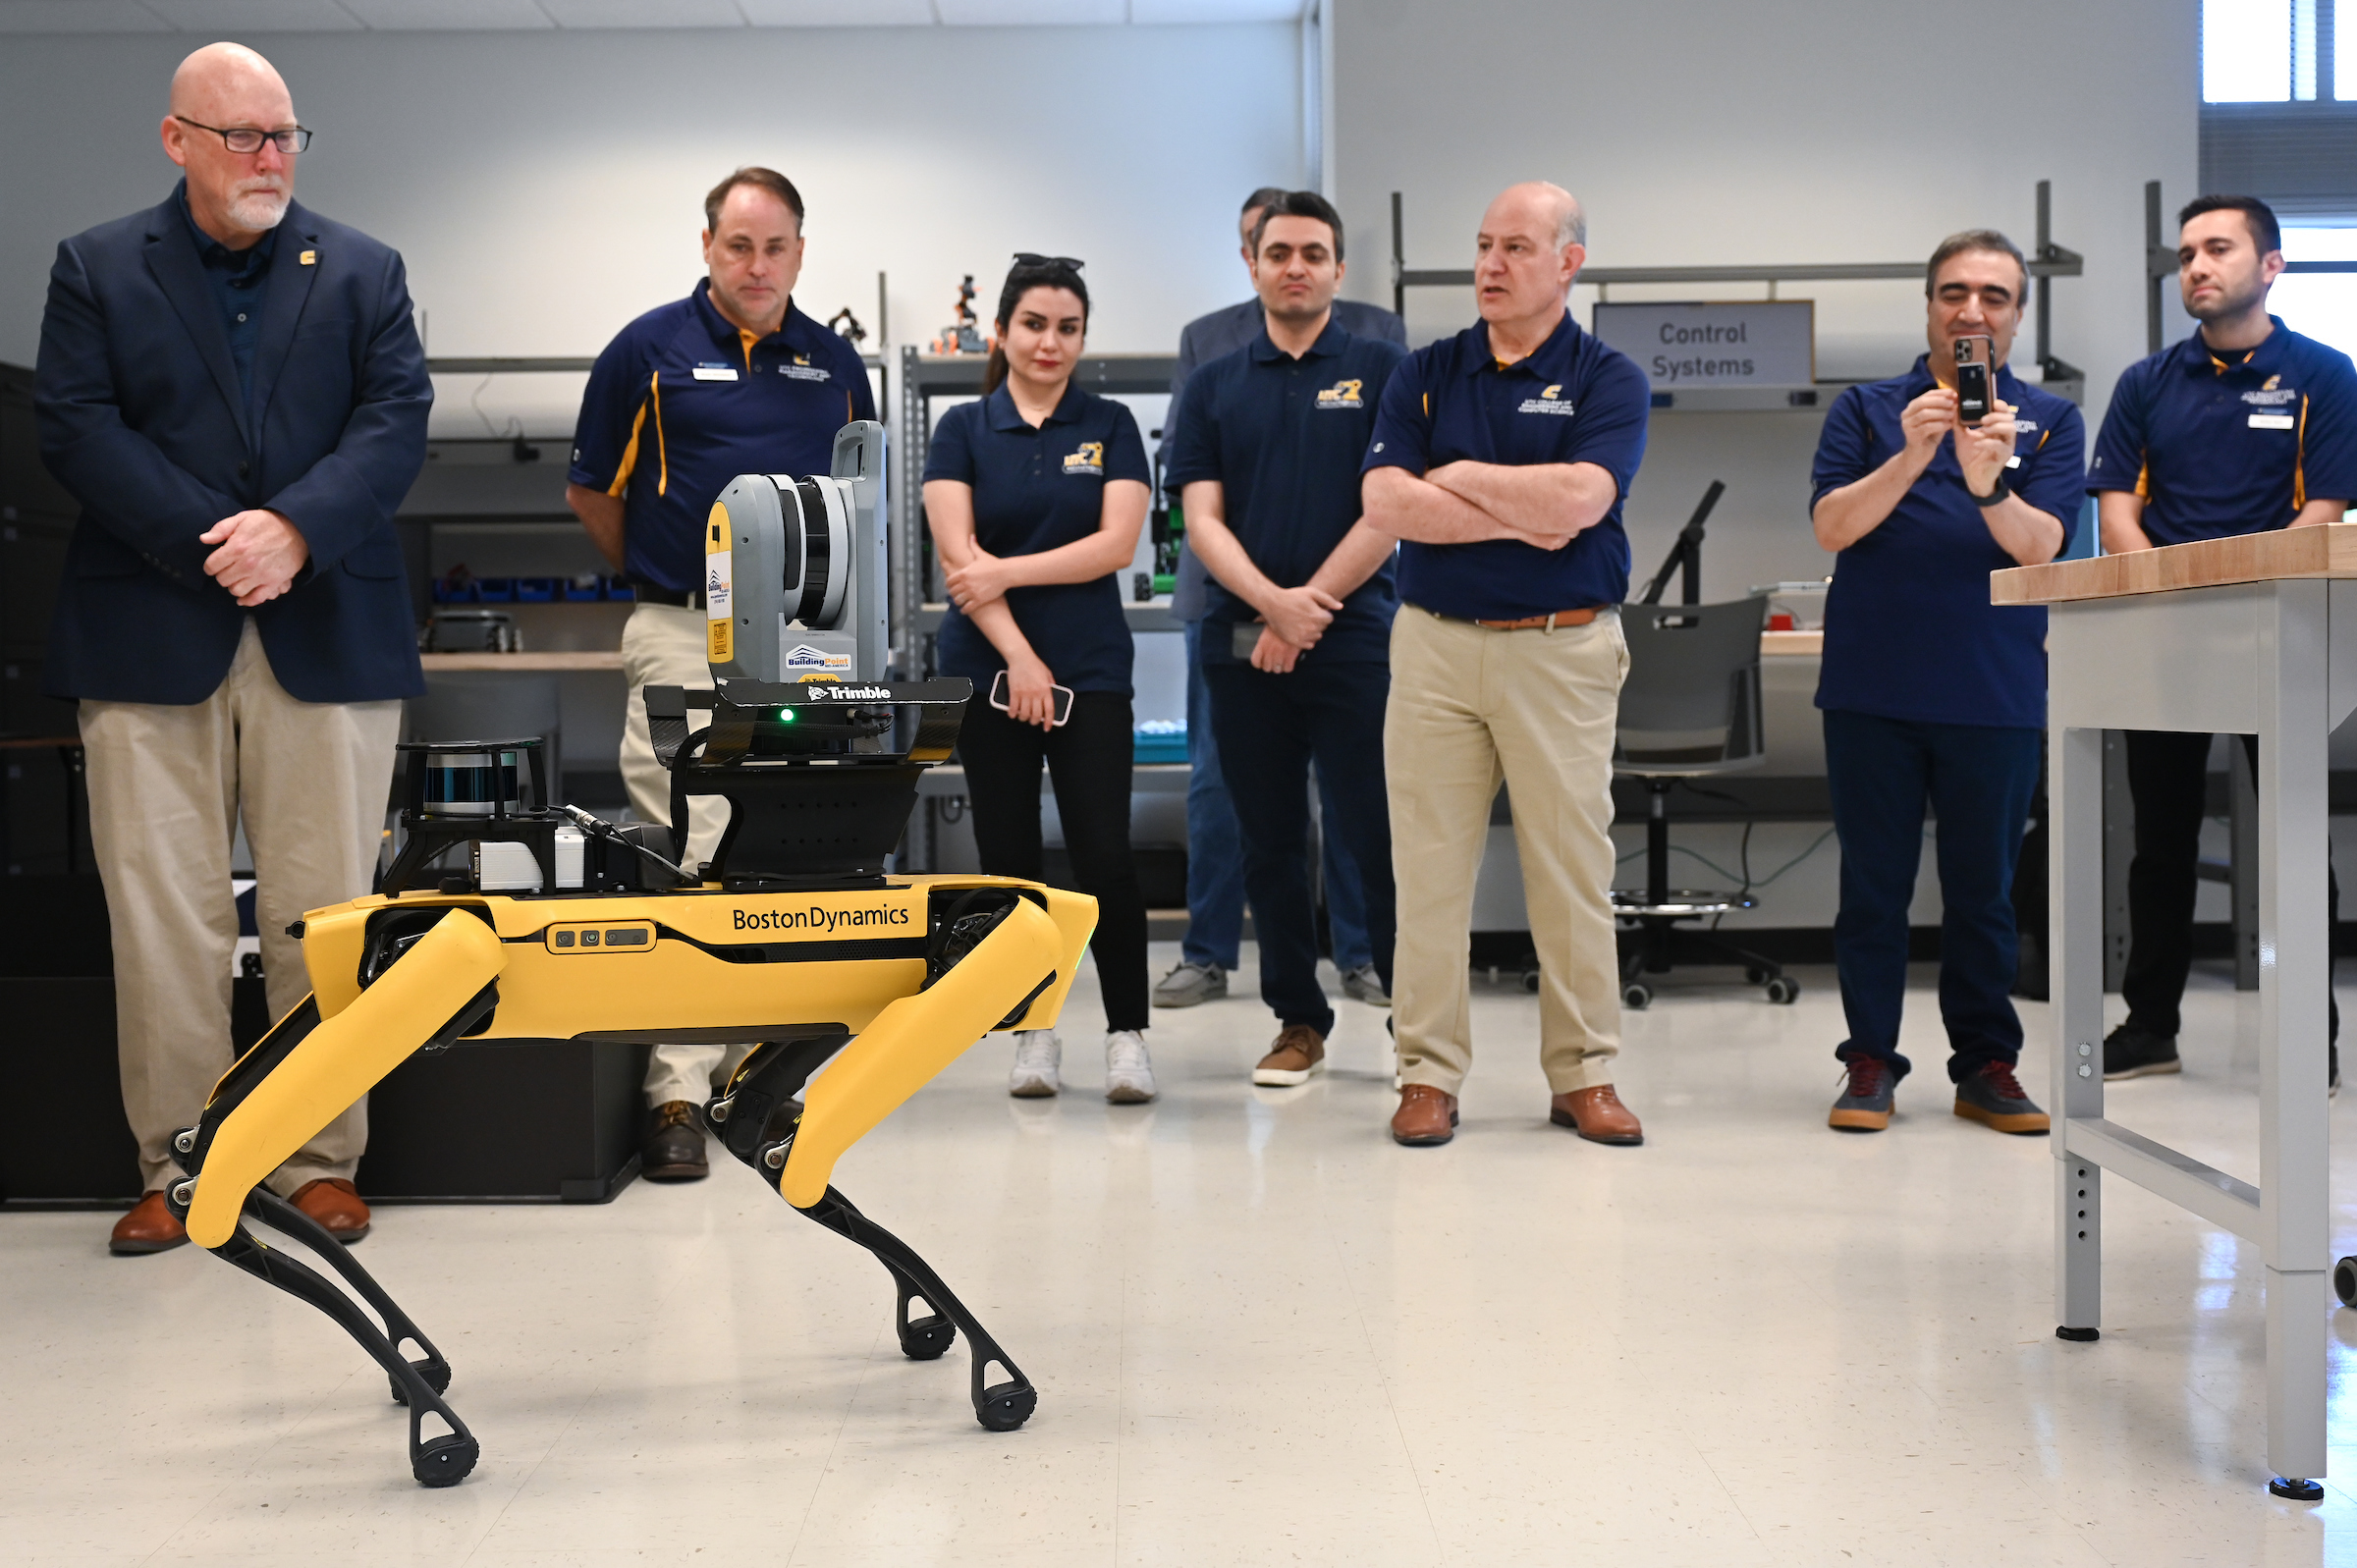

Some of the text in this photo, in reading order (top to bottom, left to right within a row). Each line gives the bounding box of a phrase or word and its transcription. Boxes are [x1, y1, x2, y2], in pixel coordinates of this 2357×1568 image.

[1659, 321, 1747, 345] Control
[1652, 354, 1755, 382] Systems
[788, 657, 849, 667] BuildingPoint
[827, 686, 891, 700] Trimble
